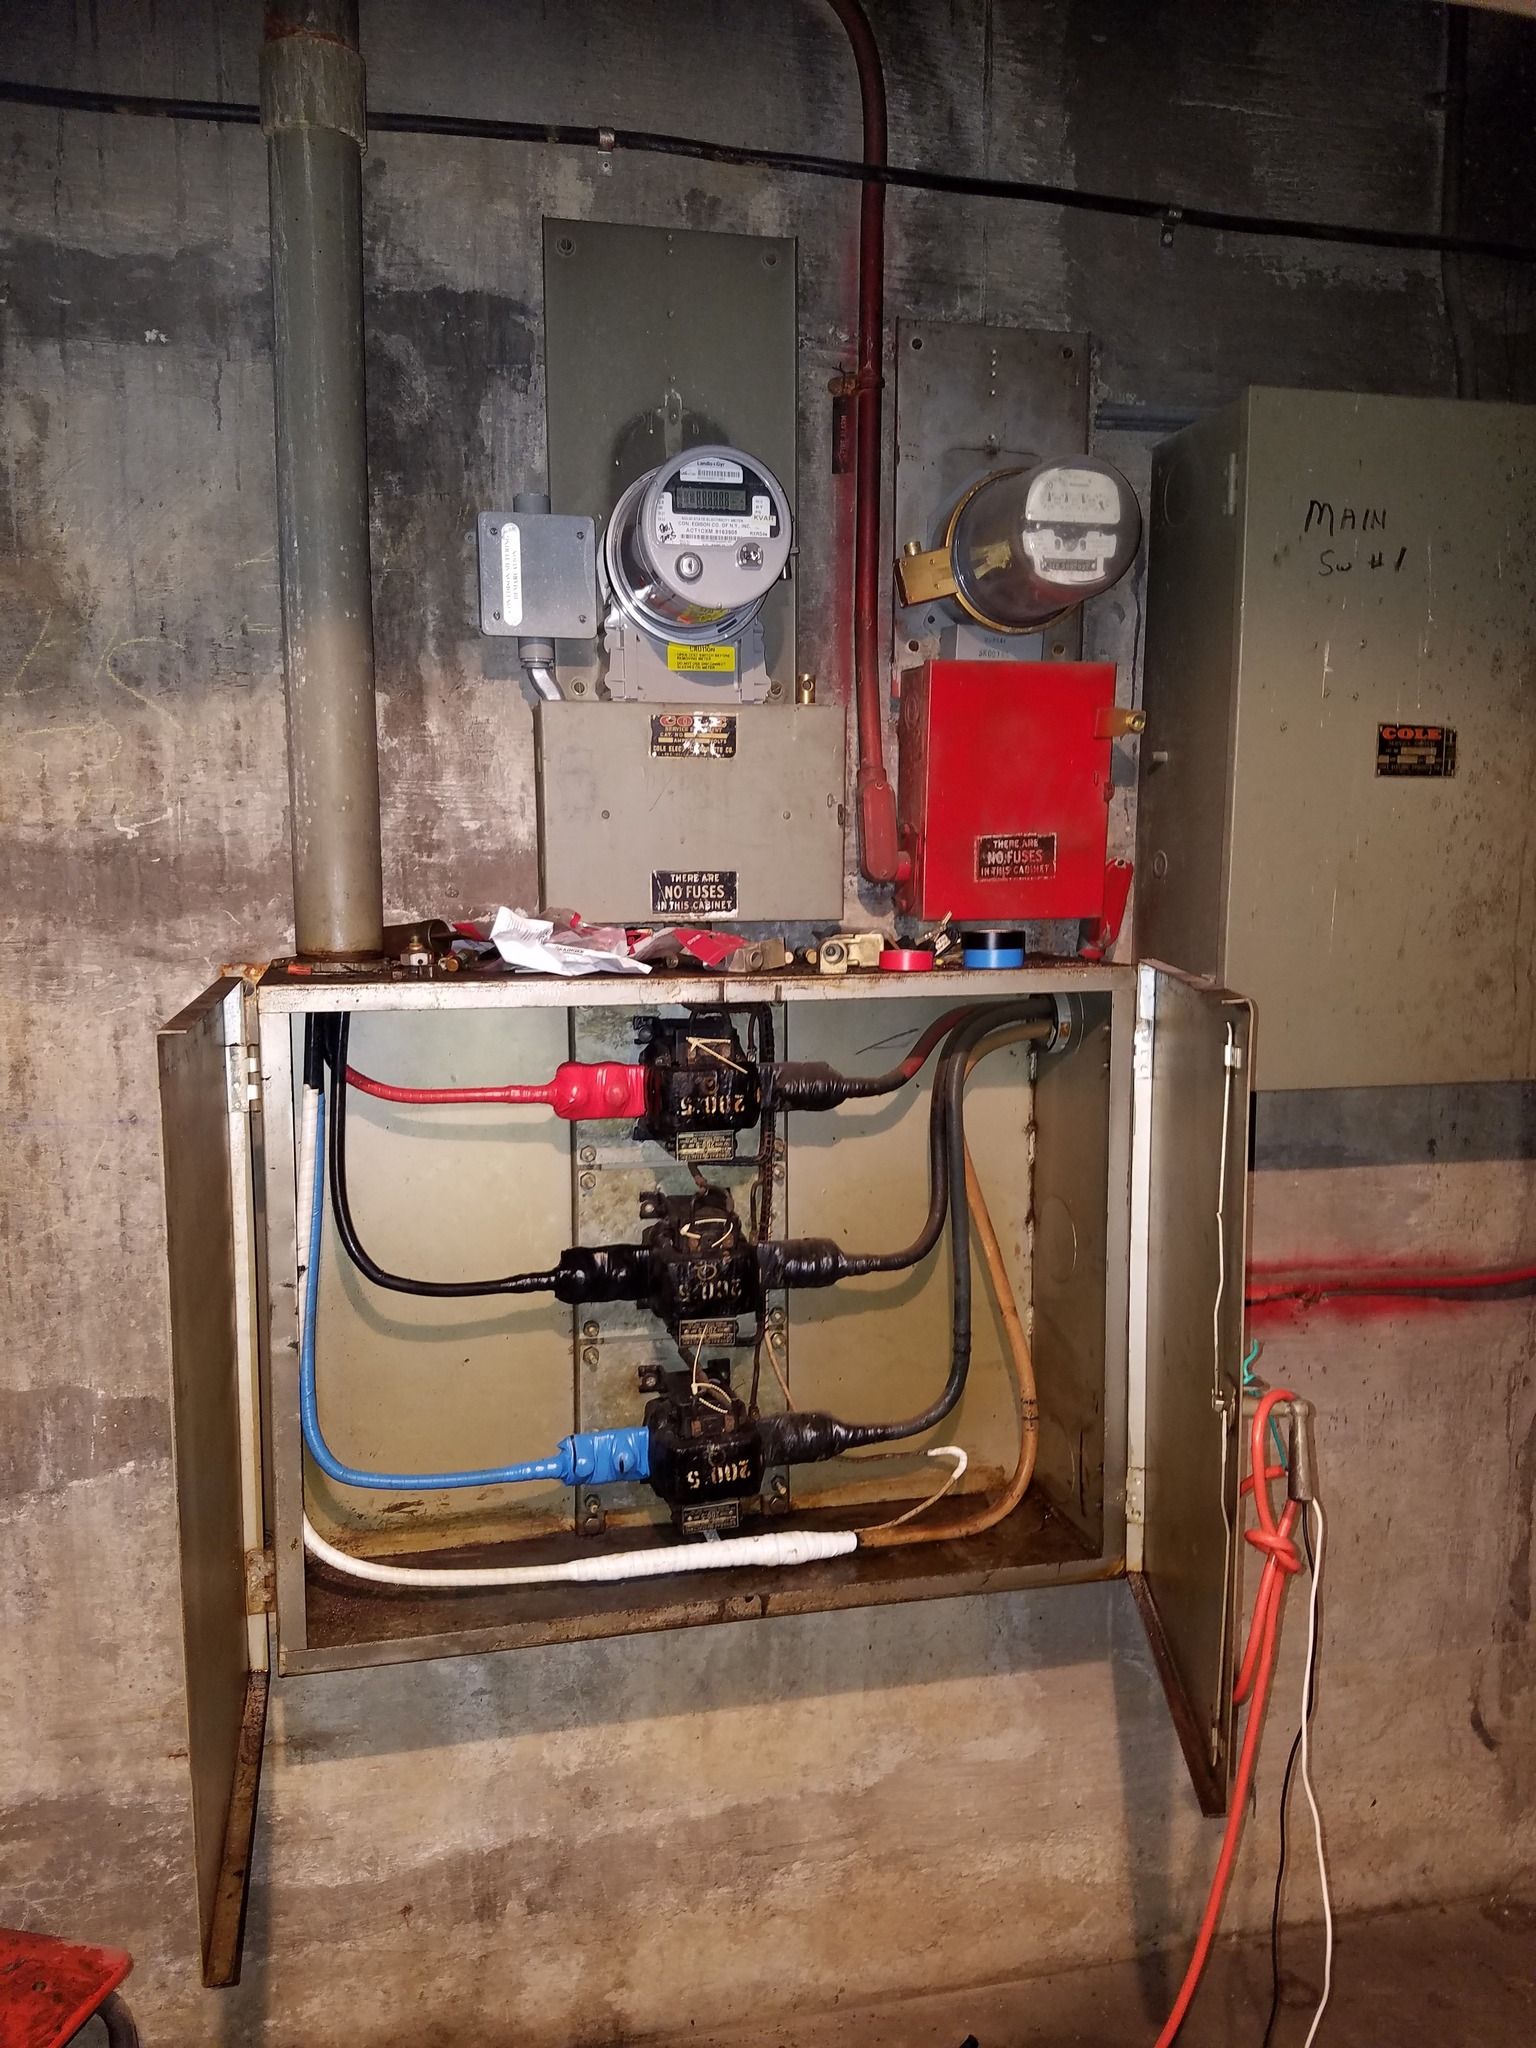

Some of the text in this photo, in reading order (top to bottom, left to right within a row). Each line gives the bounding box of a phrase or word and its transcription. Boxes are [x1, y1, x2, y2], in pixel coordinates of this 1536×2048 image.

[1304, 500, 1386, 536] MAIN
[1382, 727, 1442, 740] COLE
[992, 838, 1039, 849] THERE ARE
[987, 850, 1043, 865] NO FUSES
[981, 864, 1049, 876] IN THIS CABINET
[670, 873, 720, 883] THERE ARE
[664, 885, 725, 899] NO FUSES
[657, 900, 732, 911] IN THIS CABINET
